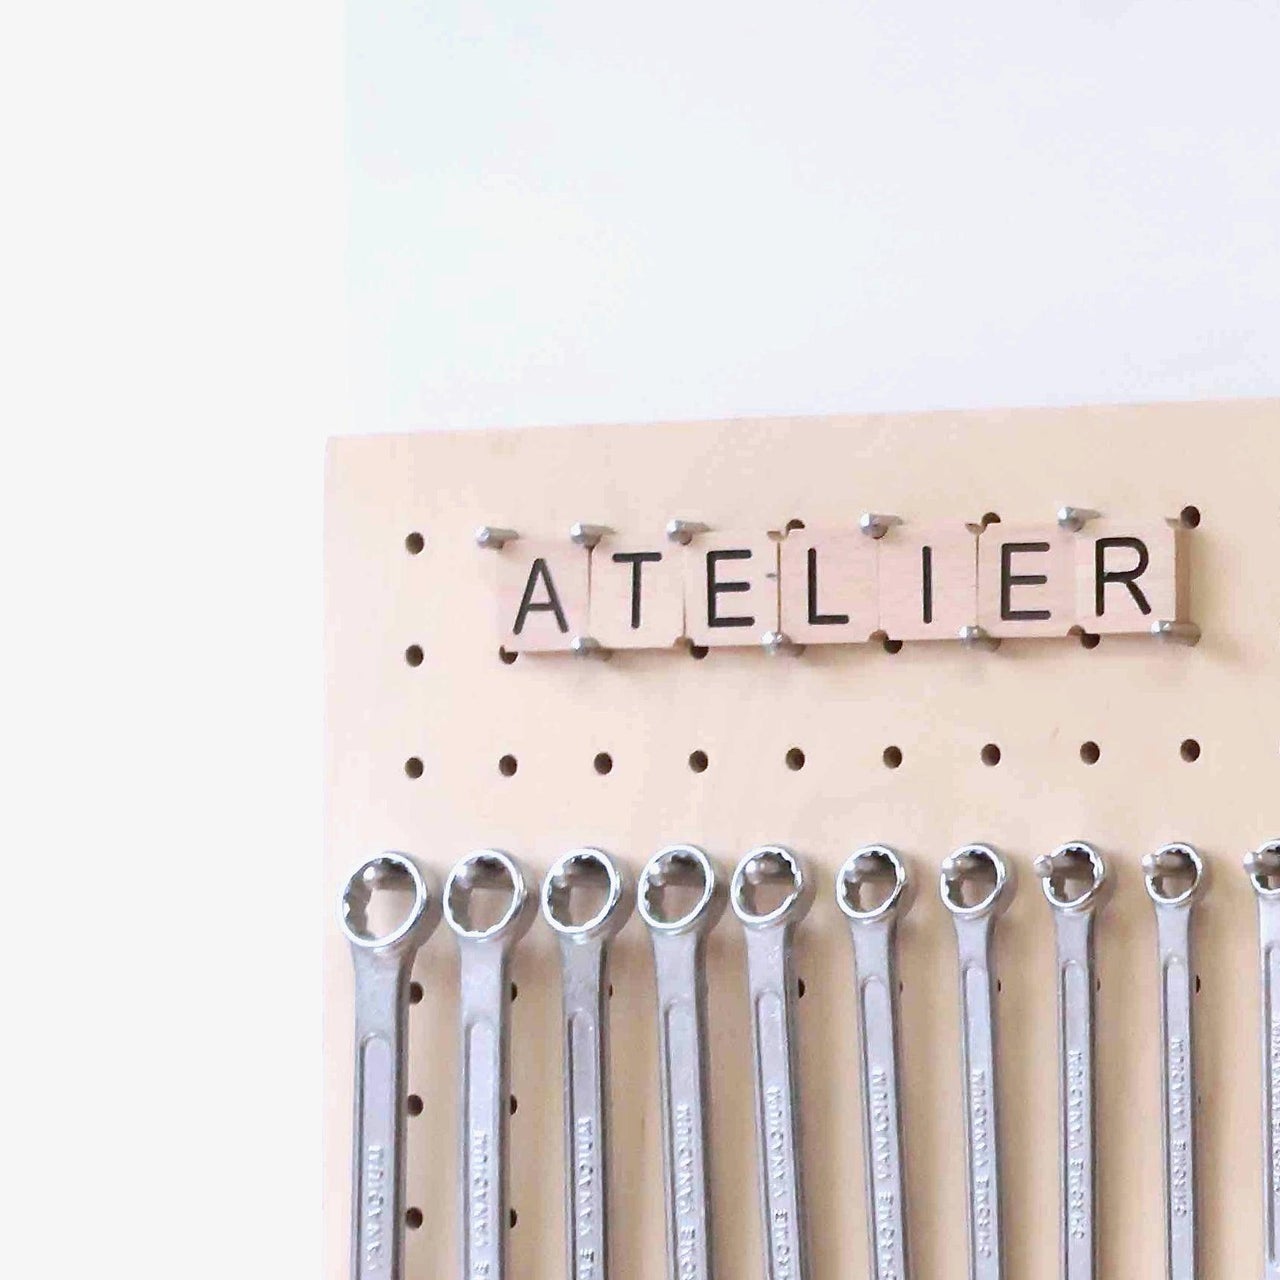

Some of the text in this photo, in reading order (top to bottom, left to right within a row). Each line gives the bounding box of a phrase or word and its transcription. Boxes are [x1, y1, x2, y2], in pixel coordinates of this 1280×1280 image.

[513, 535, 1153, 636] ATELIER
[872, 1071, 893, 1179] VANADIUM
[973, 1070, 992, 1258] CHROME VANADIUM
[1068, 1051, 1085, 1239] CHROME VANADIUM
[1171, 1037, 1187, 1217] CHROME VANADIUM
